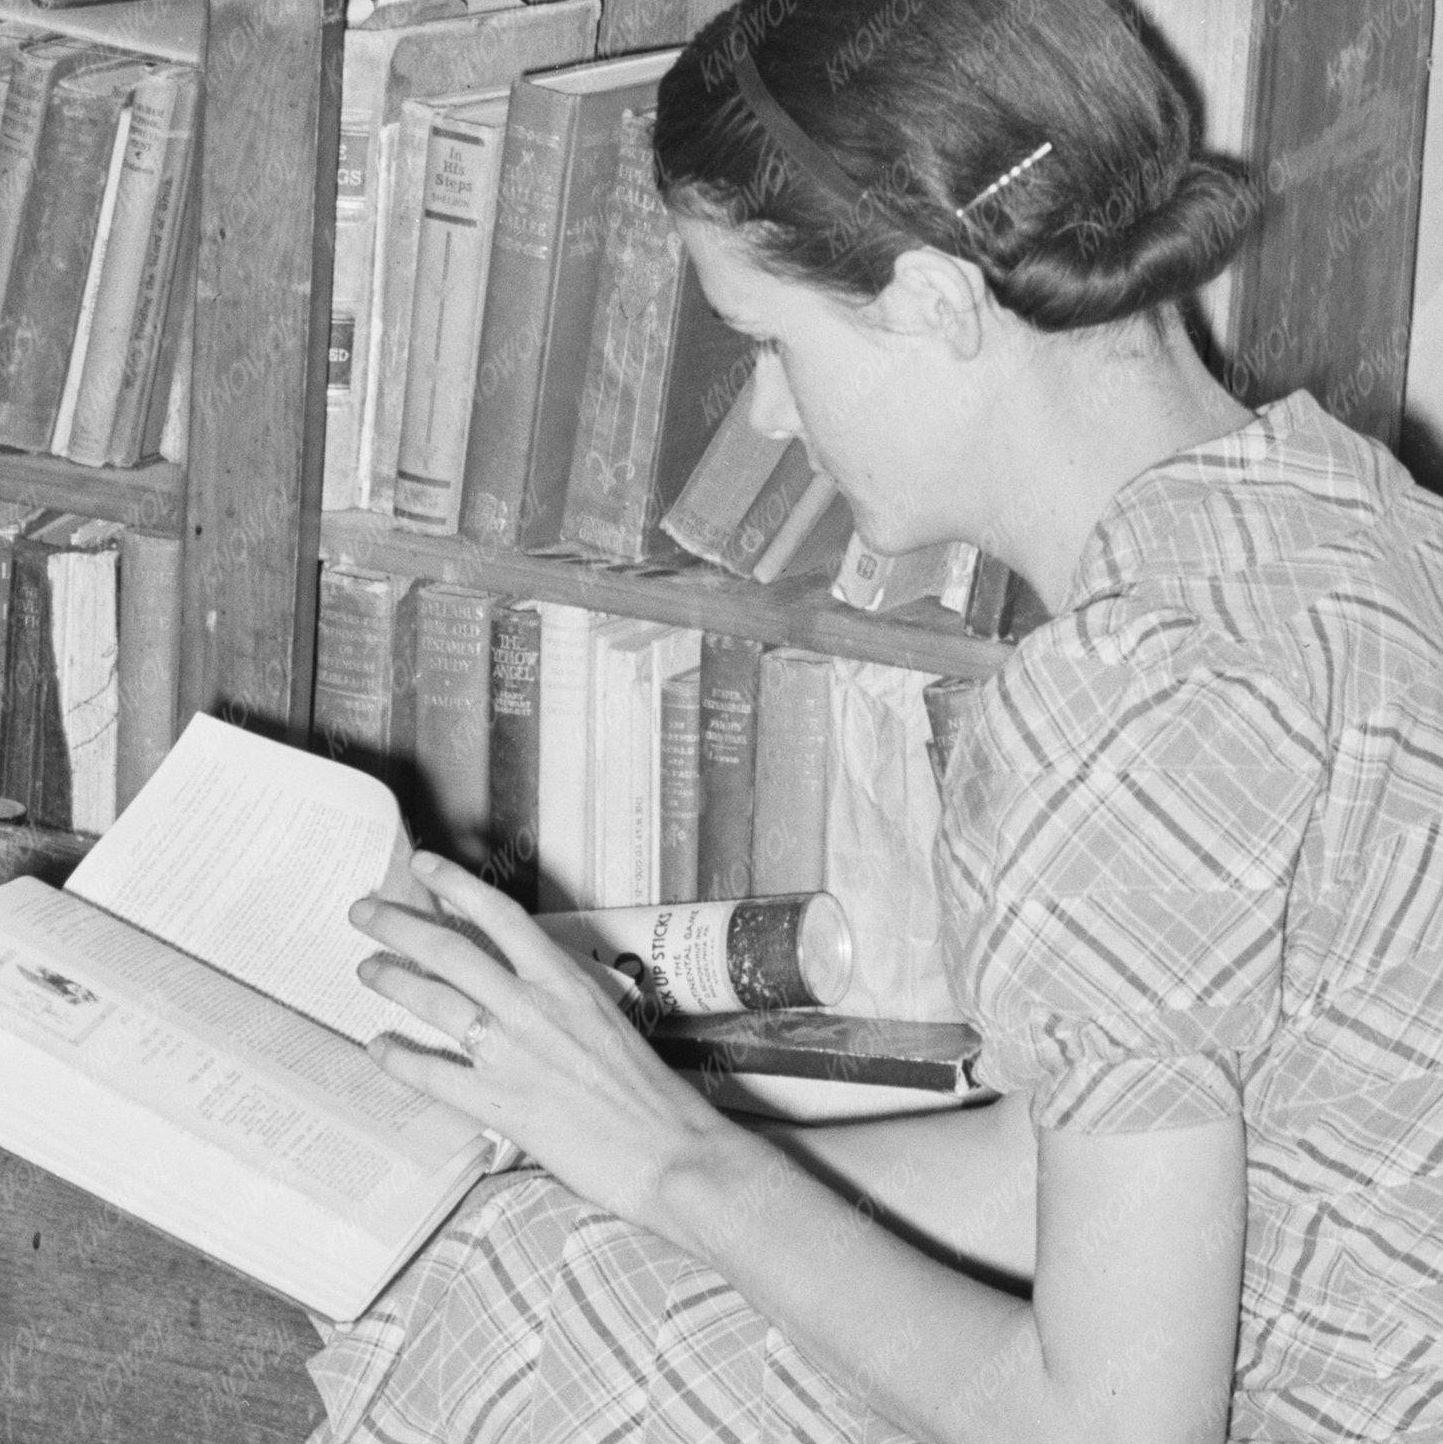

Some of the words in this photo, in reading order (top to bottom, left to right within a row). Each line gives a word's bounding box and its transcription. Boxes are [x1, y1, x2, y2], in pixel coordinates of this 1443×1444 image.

[448, 146, 462, 162] In
[443, 160, 465, 176] His
[434, 173, 473, 193] Steps
[452, 622, 481, 638] OLD
[498, 634, 528, 651] THE
[492, 647, 539, 666] YELLOW
[493, 664, 536, 682] ANGEL
[684, 909, 700, 940] GAME
[651, 912, 673, 961] STICKS
[673, 953, 683, 977] THE
[652, 965, 669, 987] UP
